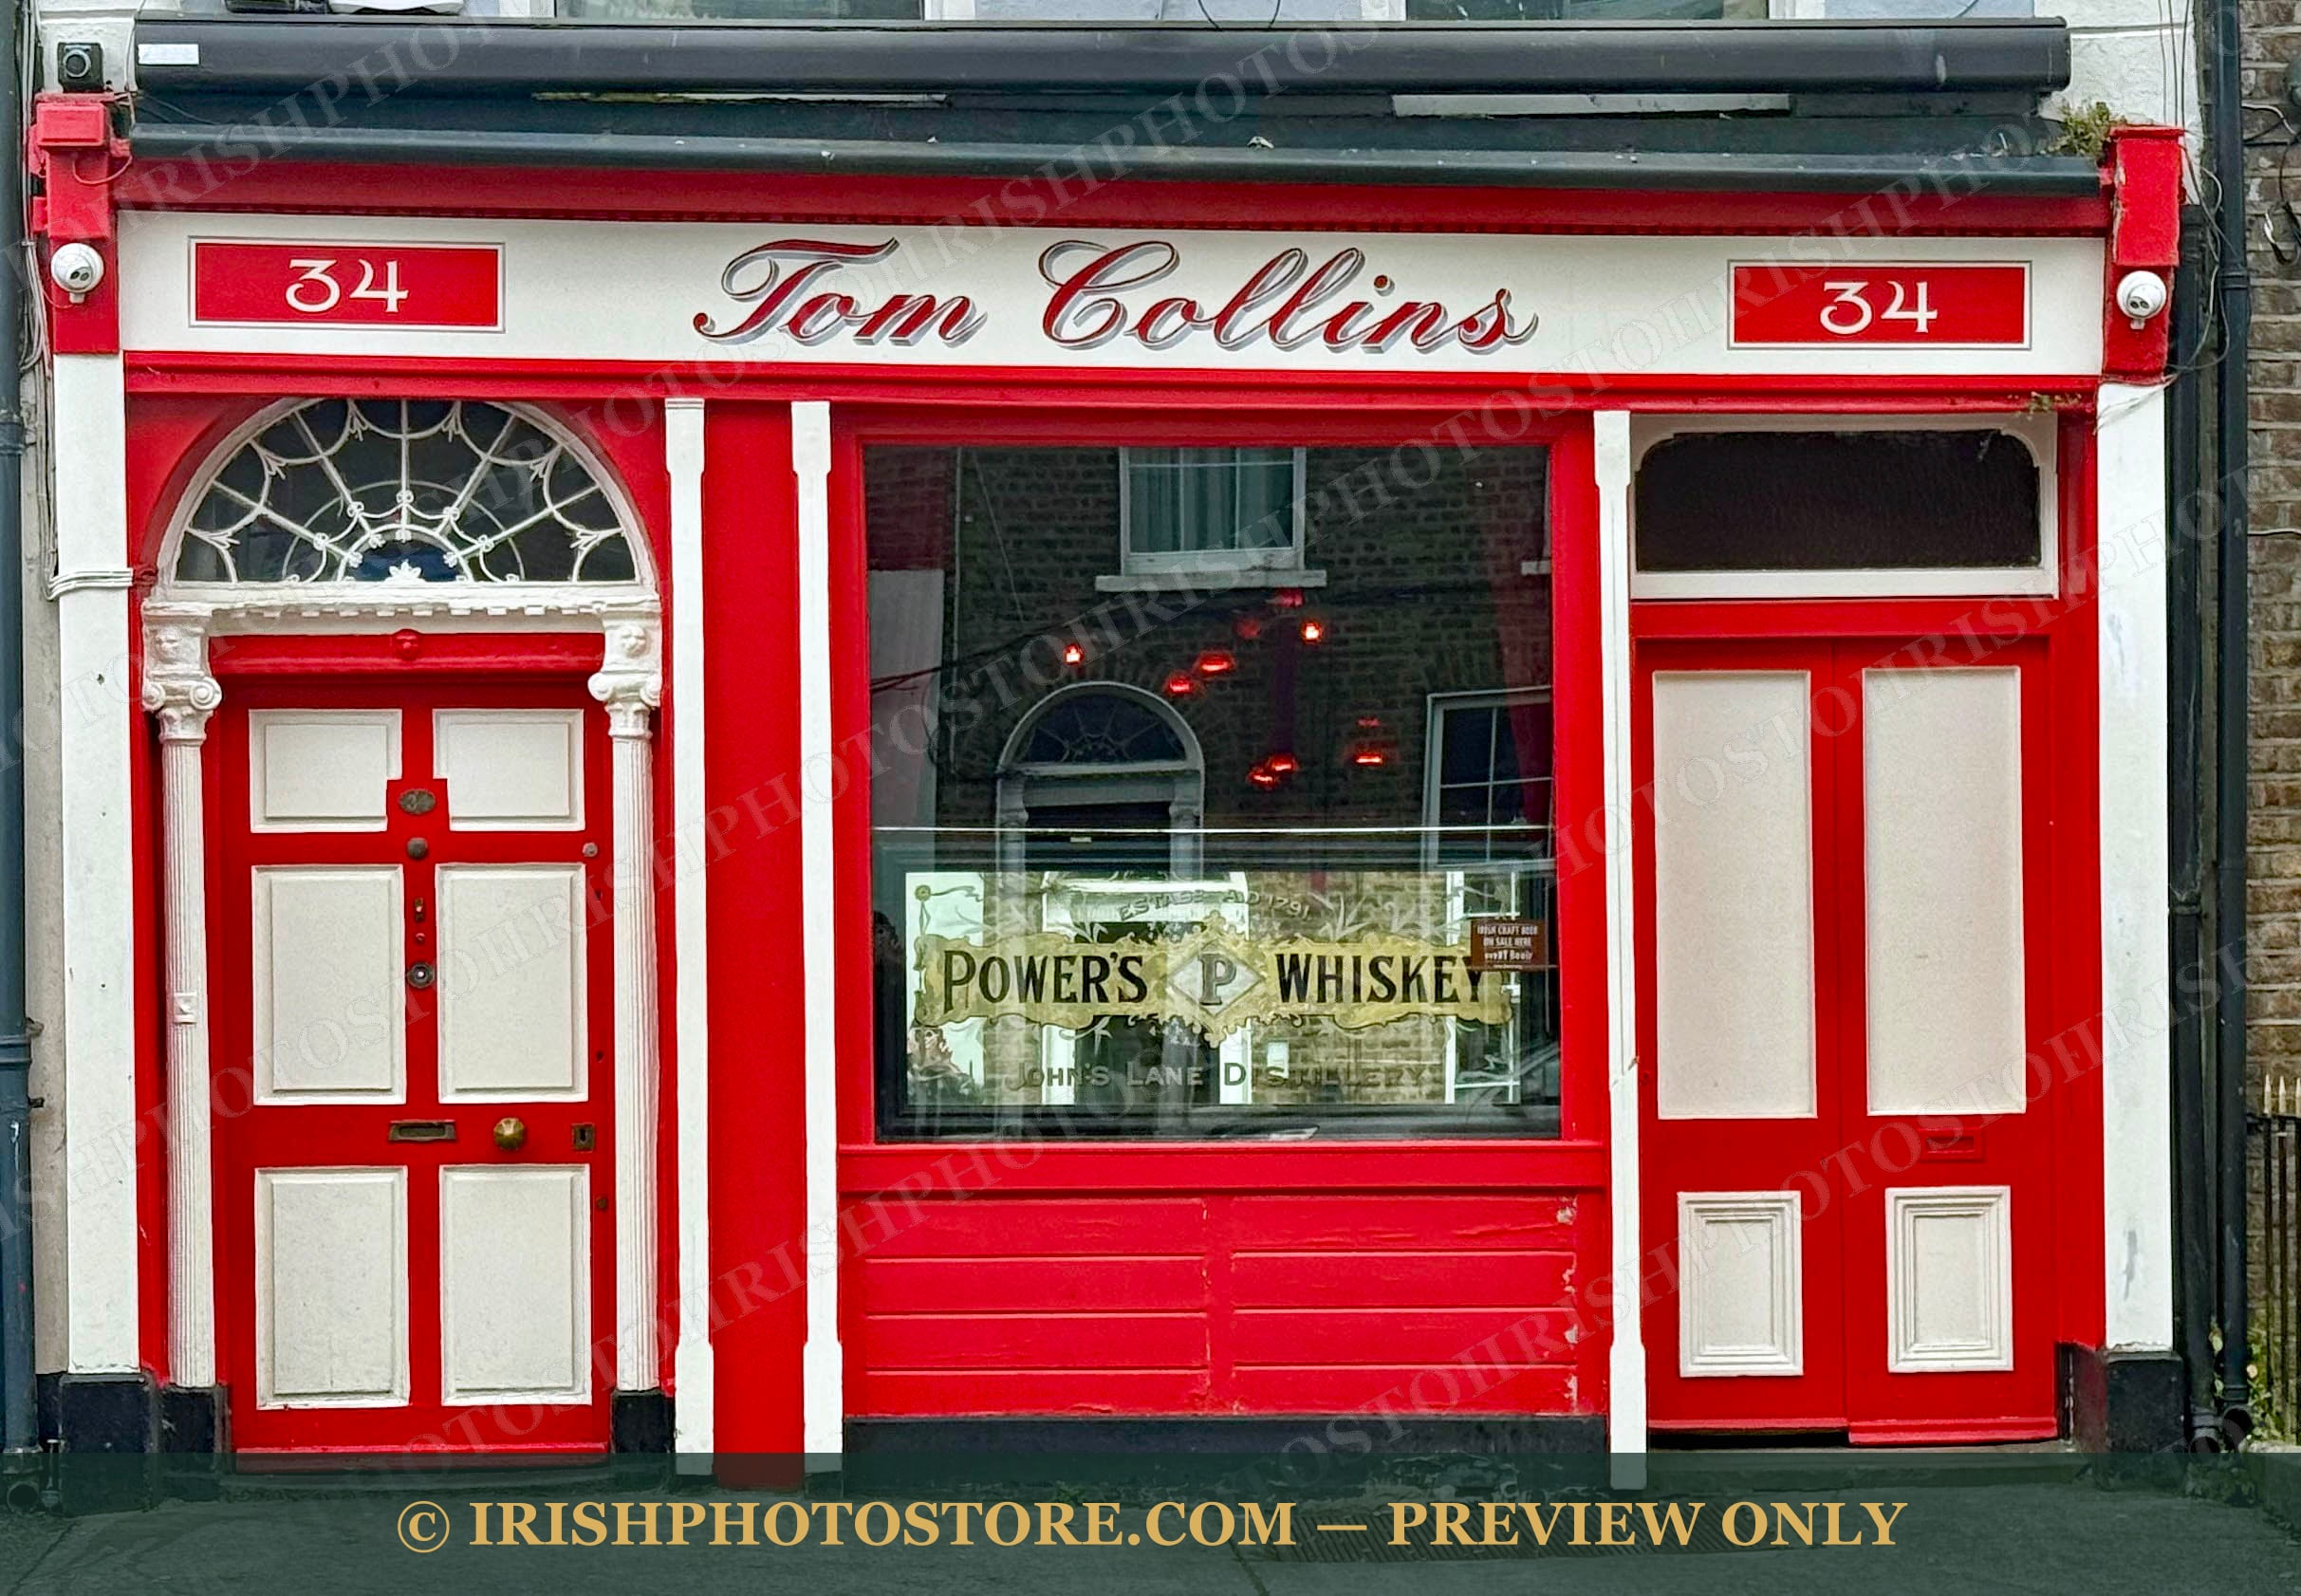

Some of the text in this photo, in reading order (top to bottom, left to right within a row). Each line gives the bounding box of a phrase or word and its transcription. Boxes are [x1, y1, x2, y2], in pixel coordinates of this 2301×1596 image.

[285, 258, 409, 314] 34
[693, 235, 1541, 355] Tom Collins
[1819, 281, 1939, 335] 34
[943, 950, 1148, 1013] POWER'S
[1275, 953, 1481, 1003] WHISKEY
[1005, 1061, 1111, 1091] JOHN'S
[1126, 1061, 1203, 1086] LANE
